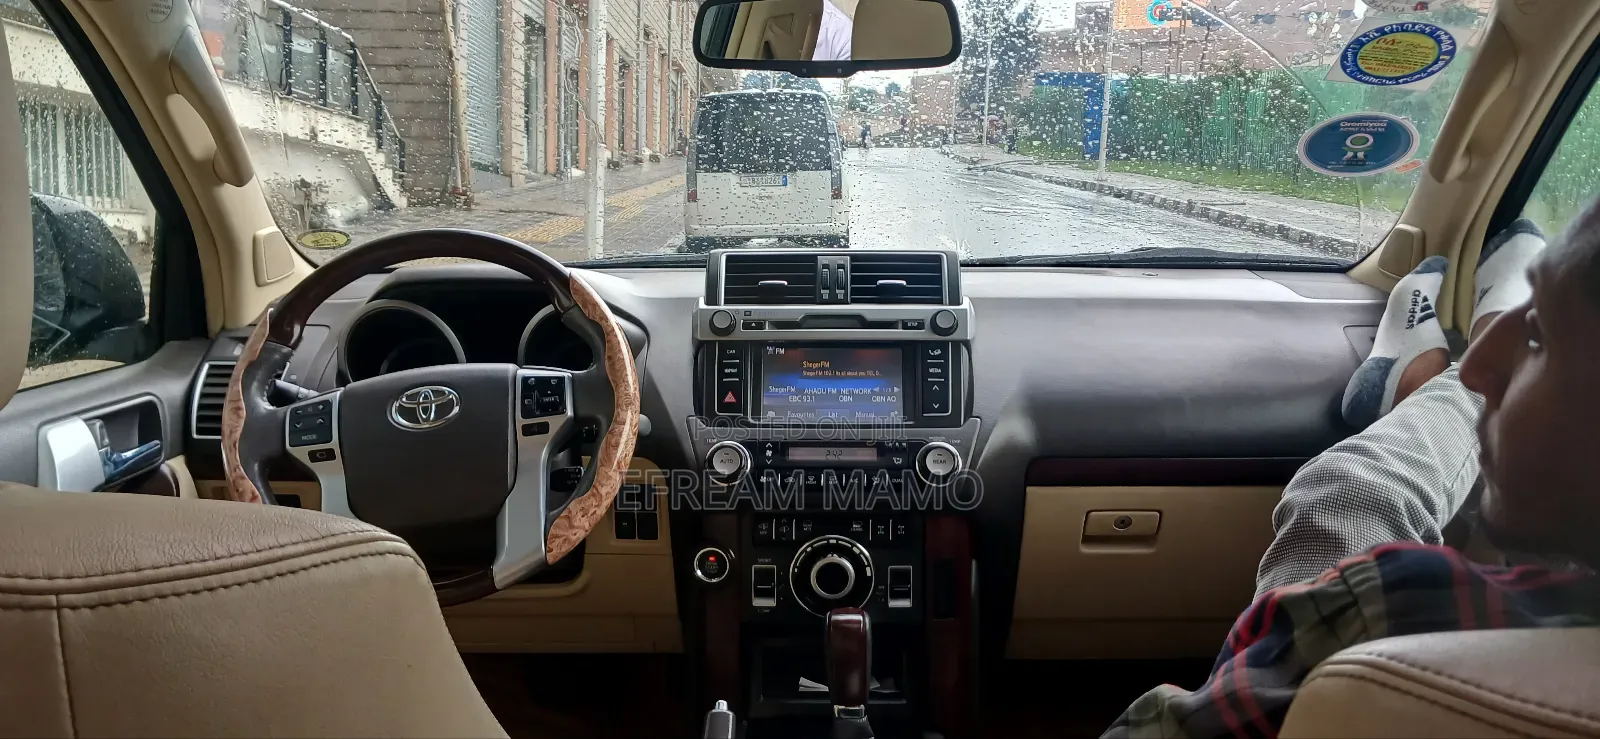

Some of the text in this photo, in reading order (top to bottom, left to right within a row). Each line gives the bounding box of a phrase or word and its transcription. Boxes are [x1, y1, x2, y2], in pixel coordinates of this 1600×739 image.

[1405, 289, 1421, 330] adidas
[775, 347, 785, 355] FM
[827, 387, 837, 395] FM
[840, 387, 872, 395] NETWORK
[788, 395, 802, 403] EBC
[802, 395, 815, 403] 93.1
[828, 410, 839, 418] List
